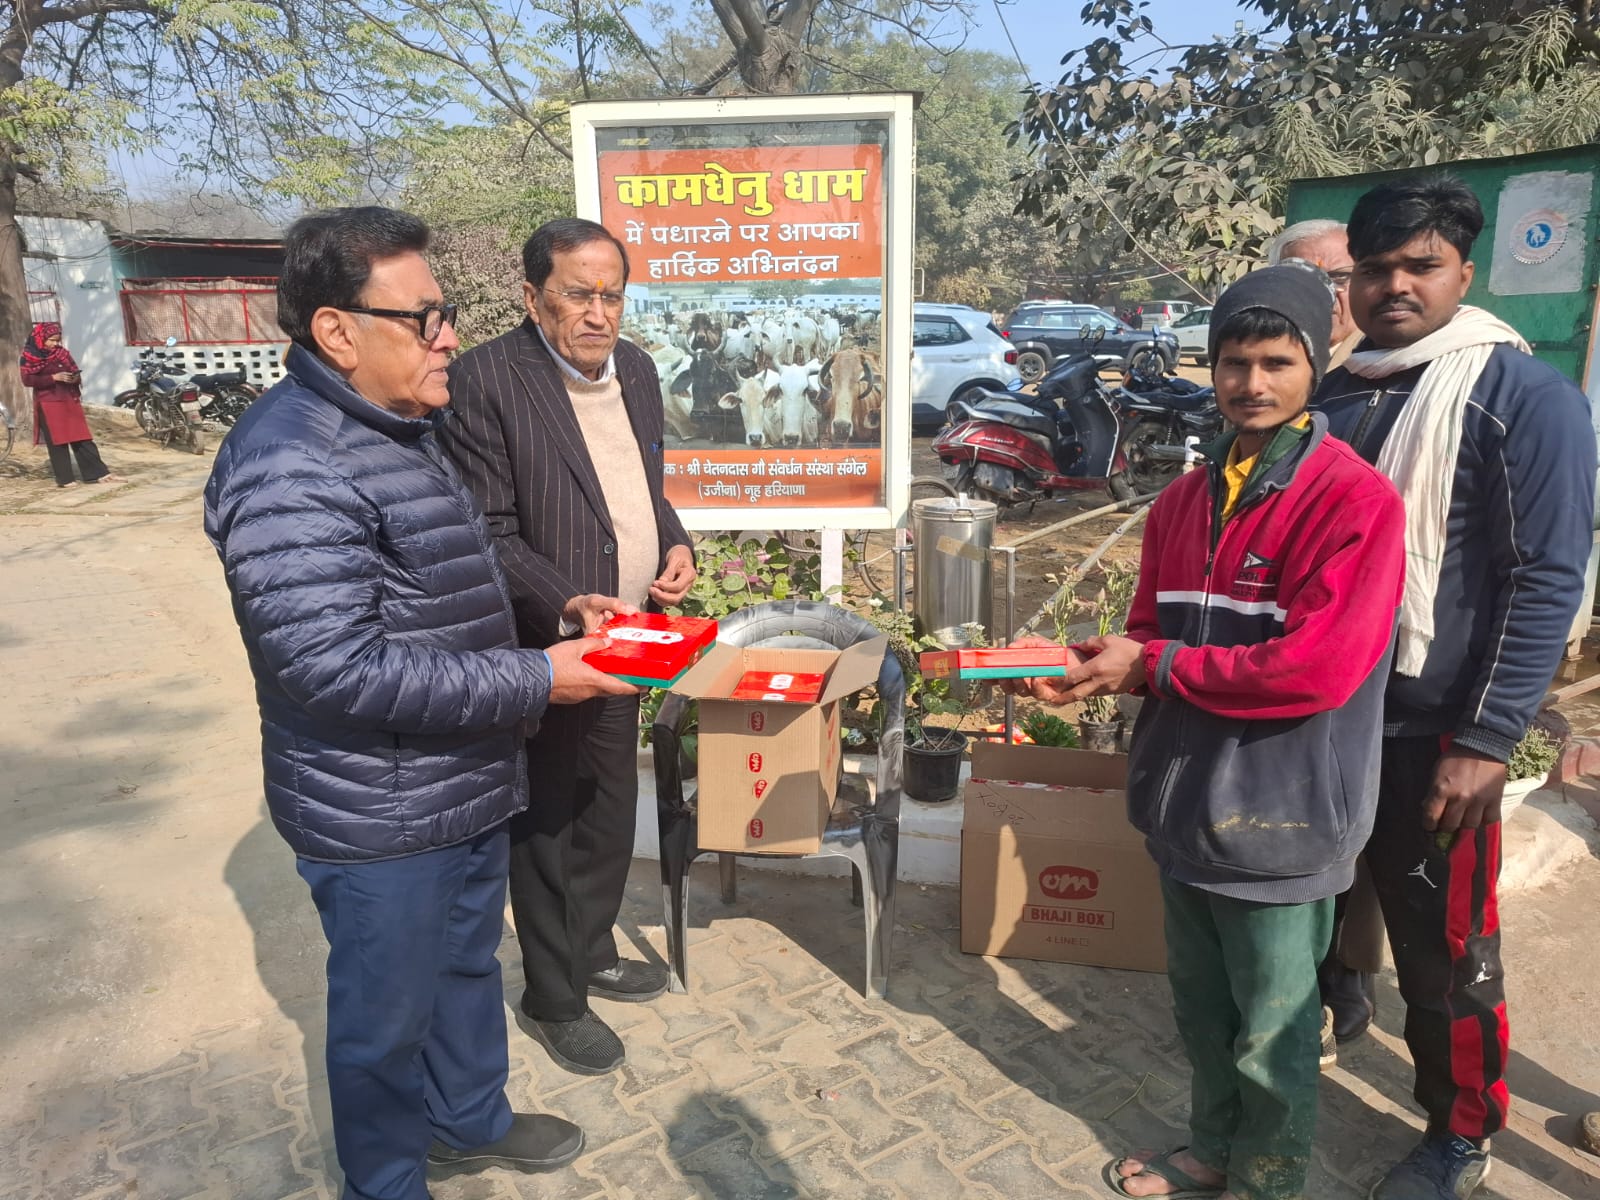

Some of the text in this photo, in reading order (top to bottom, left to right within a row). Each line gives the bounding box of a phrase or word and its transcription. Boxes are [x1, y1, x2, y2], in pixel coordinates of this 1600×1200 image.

[614, 162, 867, 217] कामधेनु धाम
[625, 218, 860, 245] में पधारने पर आपका
[648, 250, 840, 278] हार्दिक अभिनंदन
[687, 458, 700, 475] श्री
[703, 459, 749, 476] चेतनदास
[768, 458, 803, 475] संवर्धन
[806, 458, 834, 476] संस्था
[698, 480, 805, 503] (उजीना) नूह हरियाणा
[1031, 908, 1105, 926] BHAJI BOX
